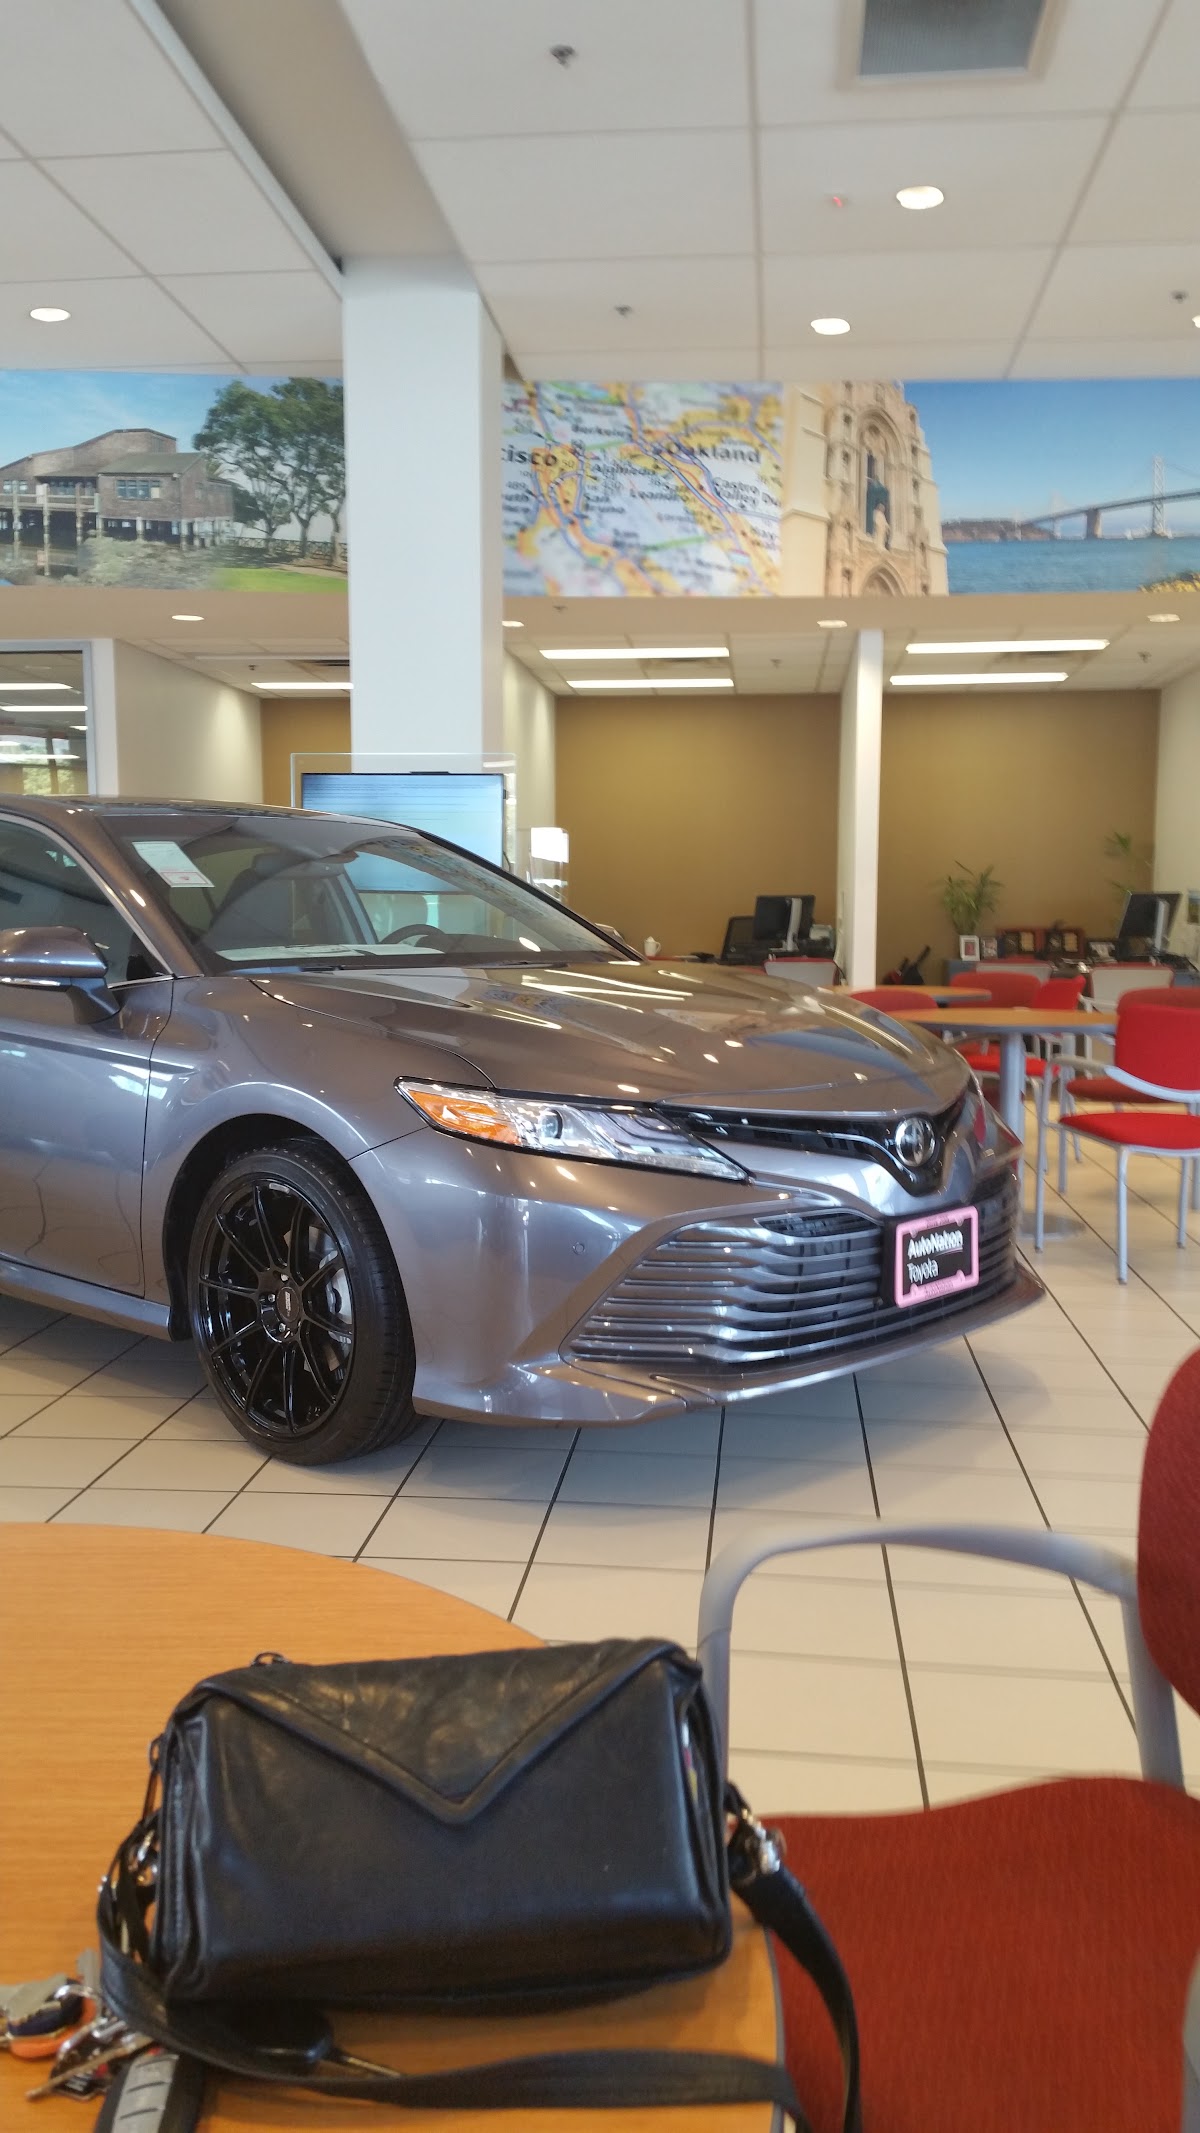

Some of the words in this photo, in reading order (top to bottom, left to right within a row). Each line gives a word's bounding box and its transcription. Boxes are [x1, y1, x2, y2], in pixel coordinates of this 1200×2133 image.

[666, 441, 761, 463] Oakland
[907, 1229, 964, 1260] AutoNation
[906, 1257, 939, 1285] Toyota
